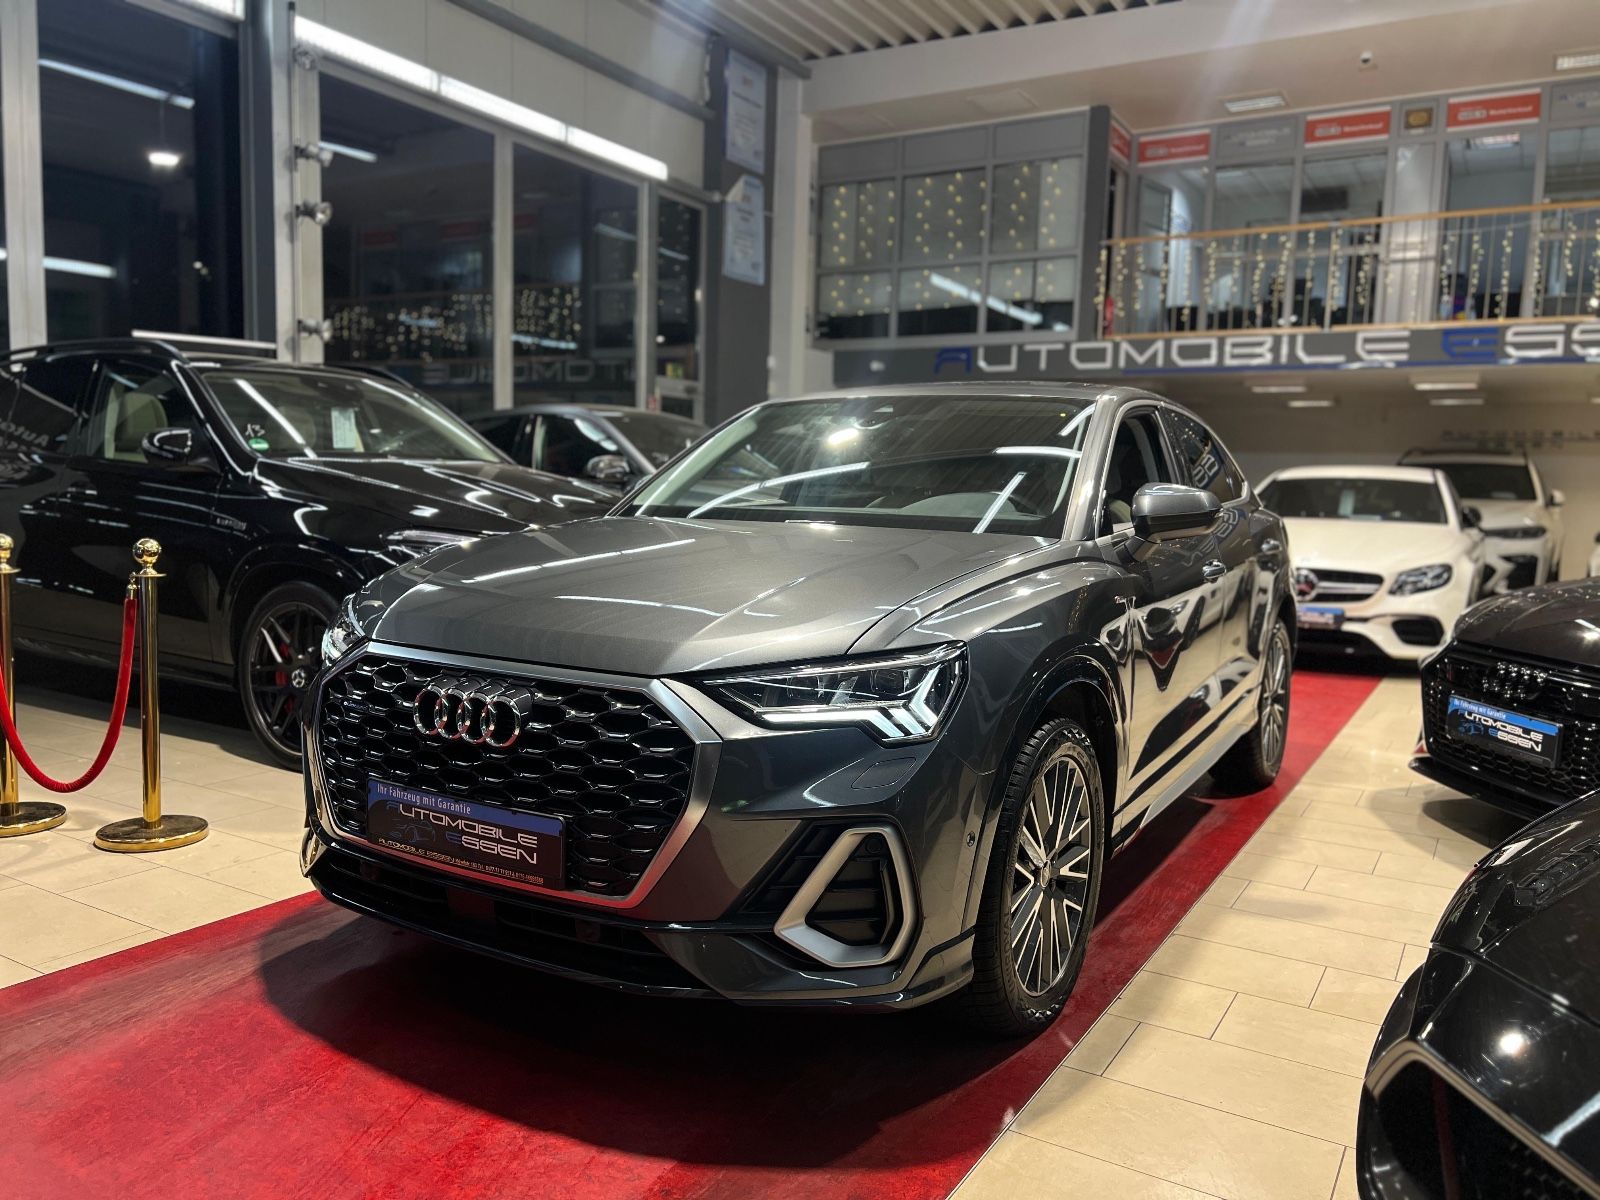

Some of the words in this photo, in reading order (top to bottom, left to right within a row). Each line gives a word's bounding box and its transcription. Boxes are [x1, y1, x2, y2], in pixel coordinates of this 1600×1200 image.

[934, 330, 1411, 374] AUTOMOBILE
[1458, 709, 1543, 741] AUTOMOBILE
[1488, 728, 1541, 752] ESSEN
[377, 783, 387, 795] Ihr
[389, 786, 420, 805] Fahrzeug
[422, 796, 435, 807] mit
[437, 798, 471, 815] Garantie
[386, 801, 538, 848] AUTOMOBILE
[446, 832, 537, 865] ESSEN
